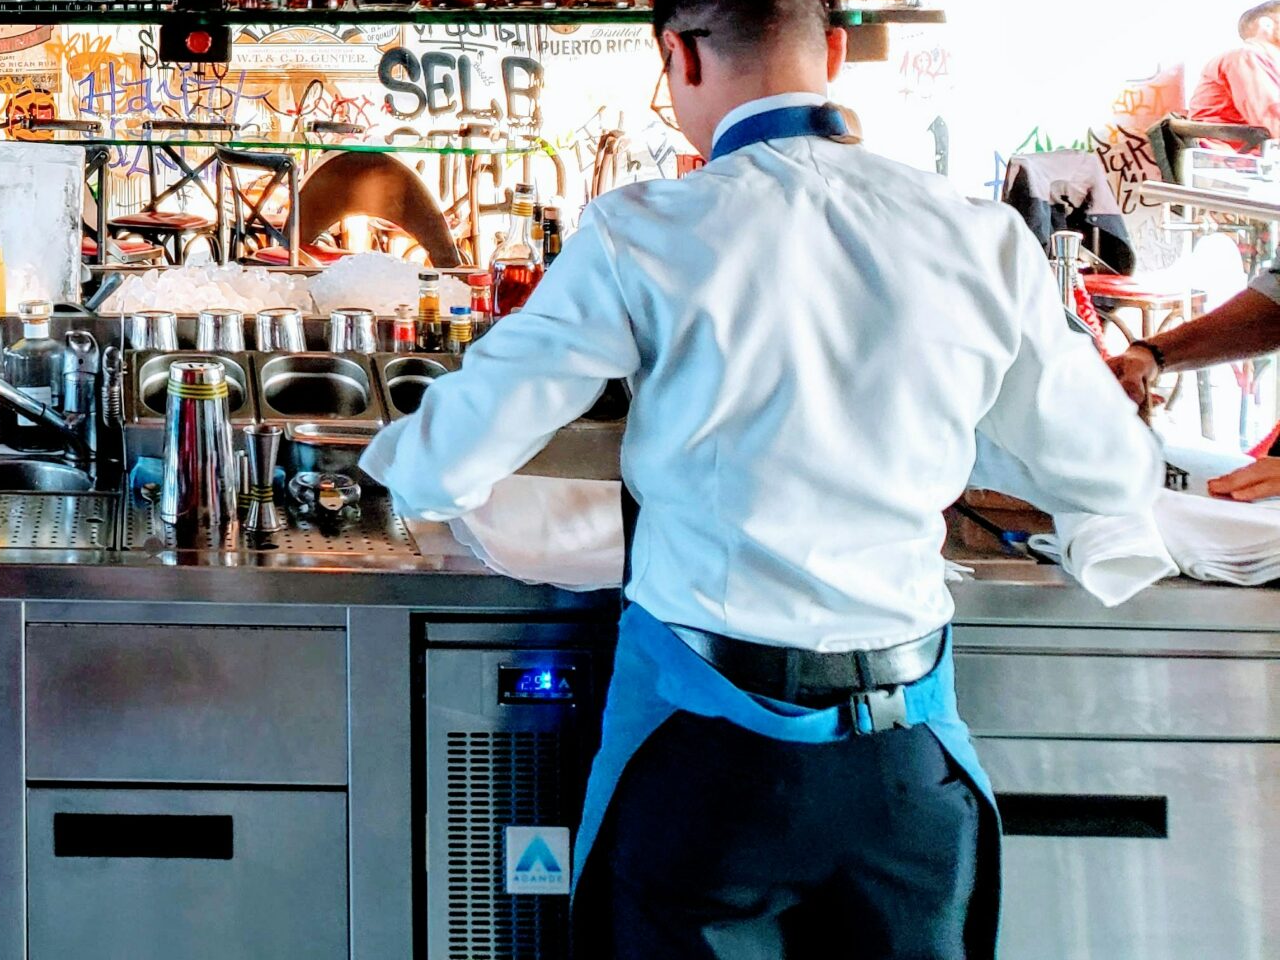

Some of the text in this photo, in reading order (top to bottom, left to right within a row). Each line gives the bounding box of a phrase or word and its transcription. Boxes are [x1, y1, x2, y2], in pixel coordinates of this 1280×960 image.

[590, 26, 642, 39] Distilled
[541, 40, 602, 56] PUERTO
[9, 60, 36, 69] RICAN
[37, 60, 58, 68] RUM
